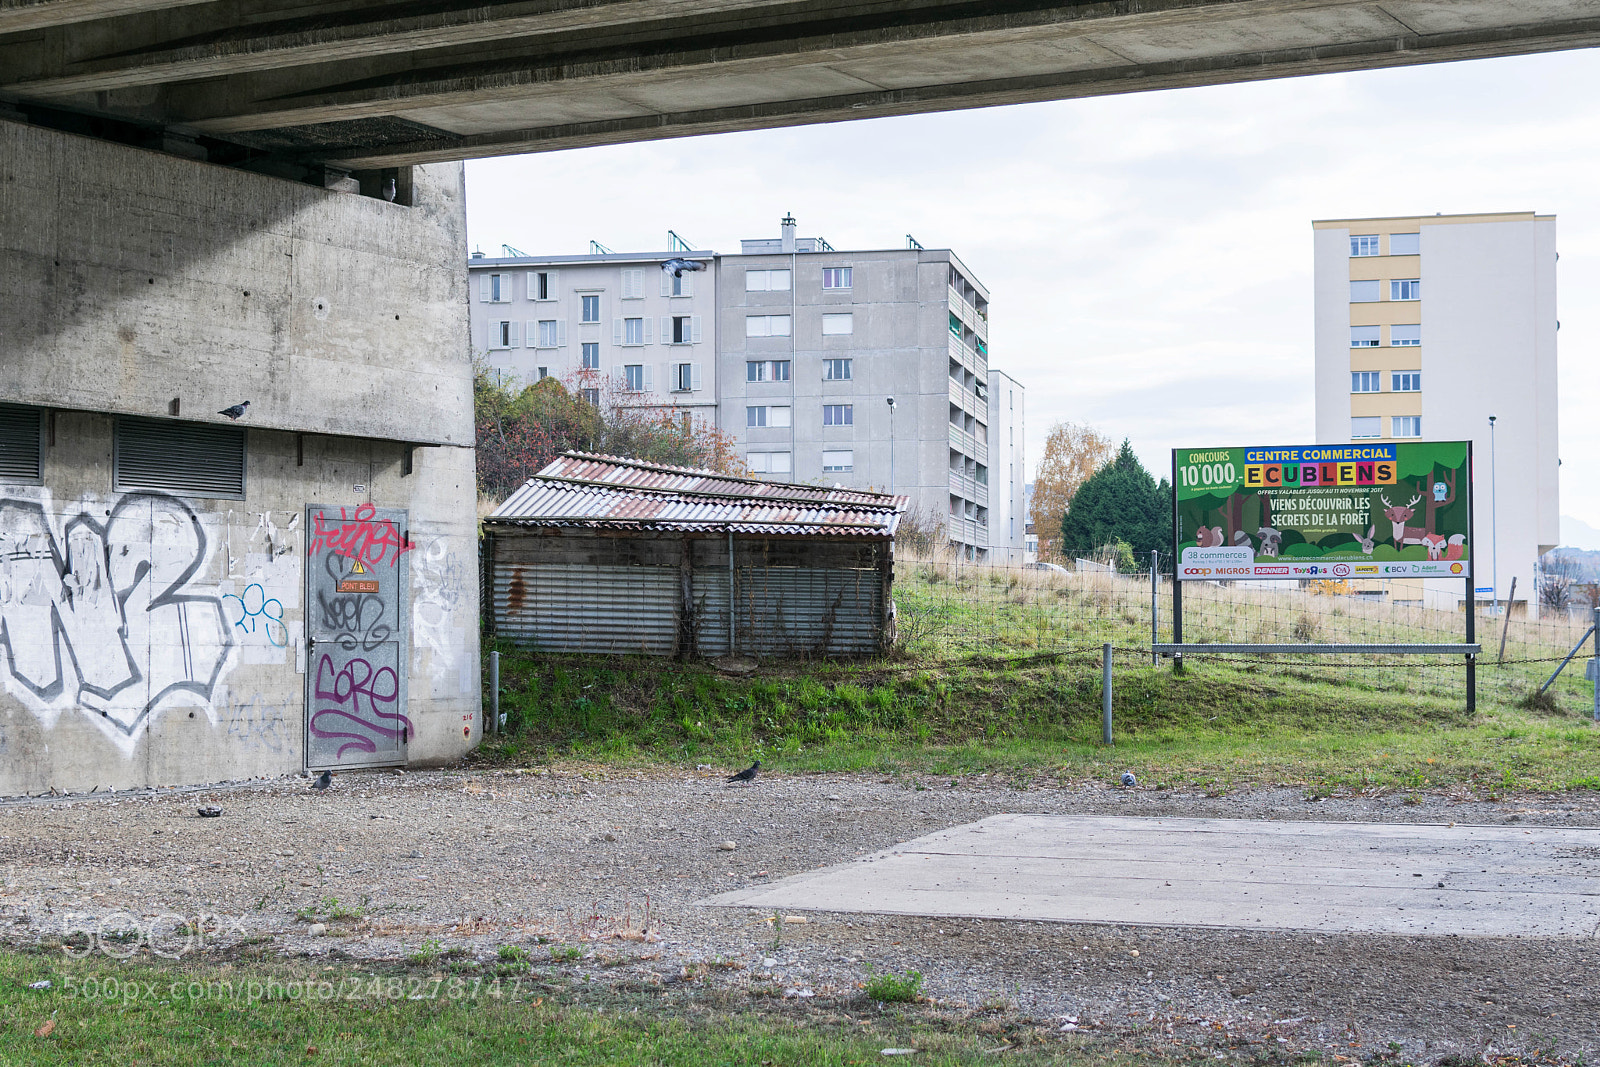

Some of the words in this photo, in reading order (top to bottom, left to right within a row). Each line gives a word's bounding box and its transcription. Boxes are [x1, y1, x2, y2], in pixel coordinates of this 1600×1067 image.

[1189, 451, 1230, 464] CONCOURS
[1247, 450, 1299, 462] CENTRE
[1302, 448, 1392, 460] COMMERCIAL
[1247, 464, 1393, 484] ECUBLENS
[1354, 497, 1371, 510] LES
[1271, 513, 1310, 526] SECRETS
[1312, 513, 1324, 525] DE
[1326, 513, 1338, 525] LA
[1340, 510, 1369, 525] FORÊT
[1188, 551, 1198, 559] 38
[1200, 551, 1247, 559] commerces
[1184, 567, 1212, 576] coop
[1215, 567, 1250, 575] MIGROS
[341, 582, 357, 590] PONT
[359, 582, 375, 590] BLEU
[462, 713, 473, 721] 216
